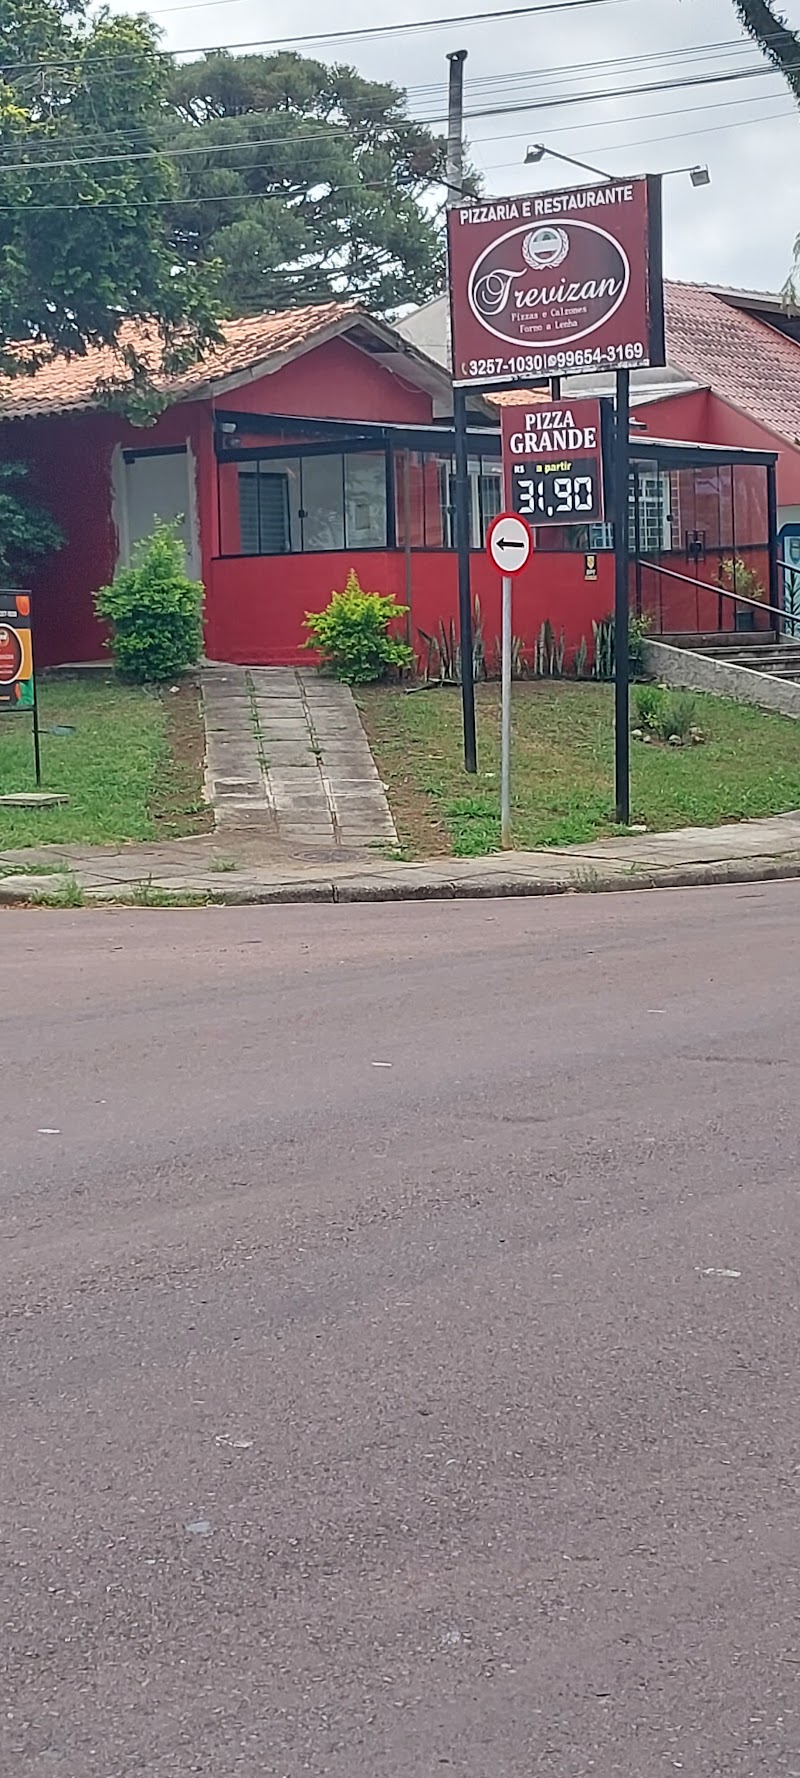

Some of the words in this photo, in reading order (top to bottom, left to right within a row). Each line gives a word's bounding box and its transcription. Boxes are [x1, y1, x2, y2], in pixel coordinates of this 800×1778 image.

[460, 204, 519, 225] PIZZARIA
[522, 202, 531, 217] E
[535, 185, 634, 216] RESTAURANTE
[473, 268, 623, 316] Trevizan
[511, 312, 539, 322] Pizzas
[550, 306, 588, 317] Calzones
[520, 324, 543, 333] Forno
[555, 319, 578, 329] Lenha
[557, 342, 643, 366] 99654-3169
[525, 410, 575, 431] PIZZA
[510, 427, 597, 454] GRANDE
[544, 461, 572, 474] partir
[517, 476, 593, 517] 31,90
